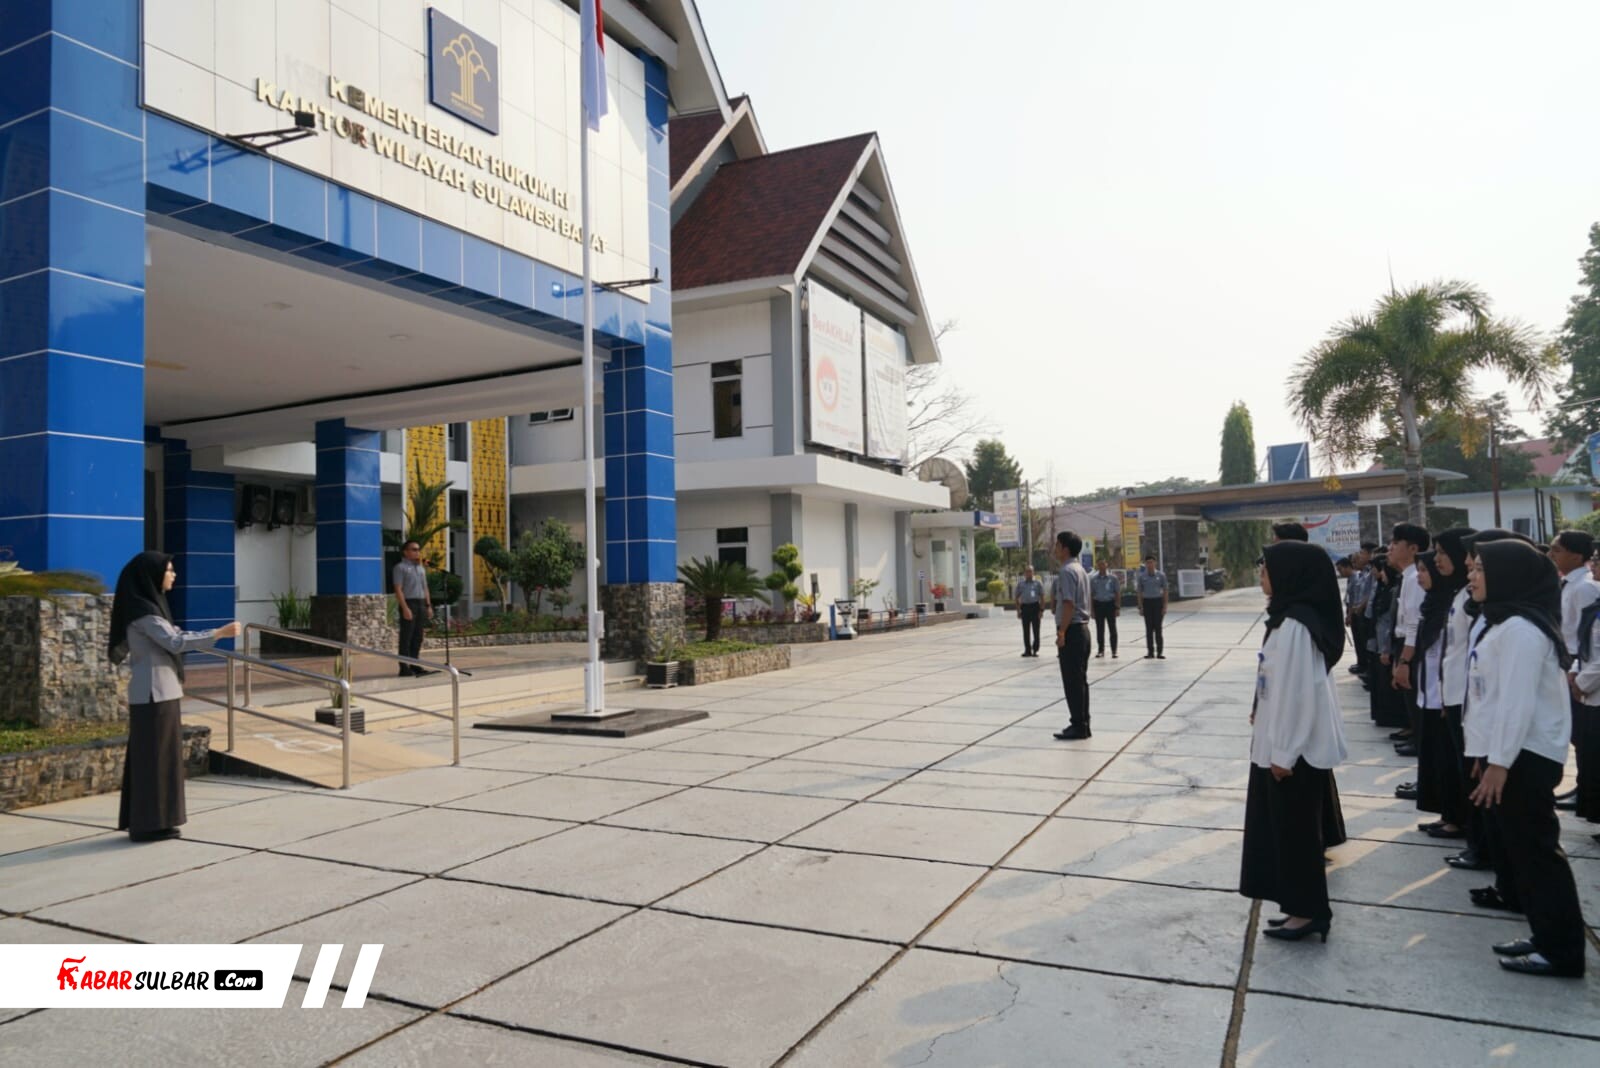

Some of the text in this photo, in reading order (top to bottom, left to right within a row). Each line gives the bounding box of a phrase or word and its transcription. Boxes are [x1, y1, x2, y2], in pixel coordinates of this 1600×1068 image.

[328, 75, 486, 169] KEMENTERIAN
[488, 155, 551, 201] HUKUM
[552, 187, 568, 211] RI
[372, 131, 467, 192] WILAYAH
[472, 179, 556, 232] SULAWESI
[559, 218, 608, 254] BAAT
